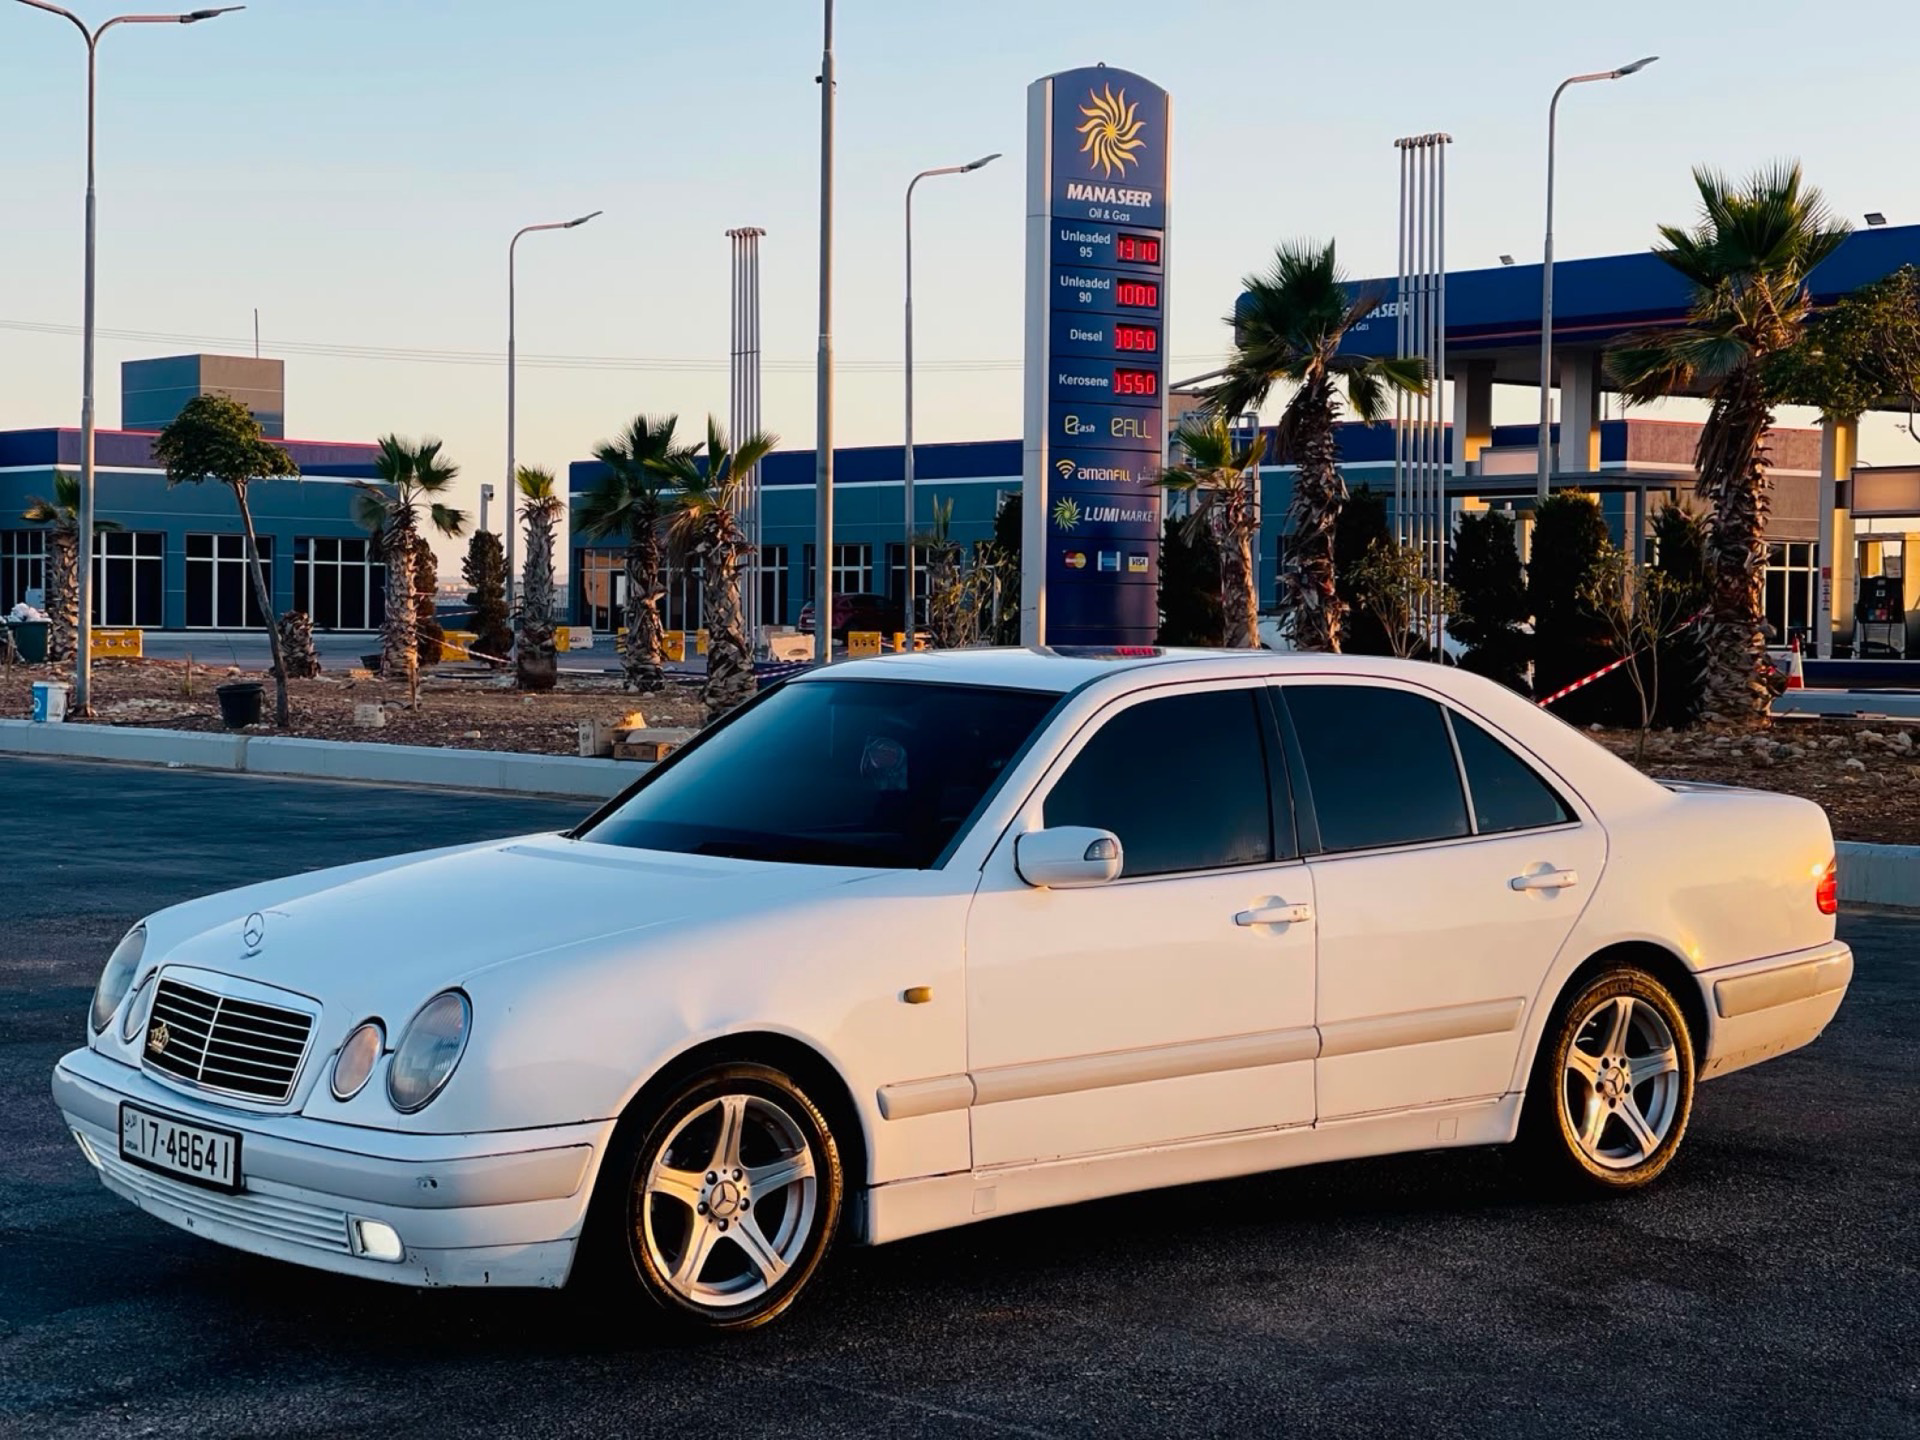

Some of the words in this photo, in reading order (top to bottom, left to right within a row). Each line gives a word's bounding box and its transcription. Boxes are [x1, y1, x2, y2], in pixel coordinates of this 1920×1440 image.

[1067, 183, 1152, 207] MANASEER
[1088, 208, 1102, 218] Oil
[1103, 209, 1110, 219] &
[1112, 210, 1130, 221] Gas
[1061, 230, 1110, 244] Unleaded
[1079, 246, 1092, 257] 95
[1060, 275, 1110, 289] Unleaded
[1079, 292, 1092, 302] 90
[1119, 285, 1156, 306] 1000
[1070, 328, 1102, 341] Diesel
[1059, 374, 1109, 386] Kerosene
[1084, 506, 1119, 523] LUMI
